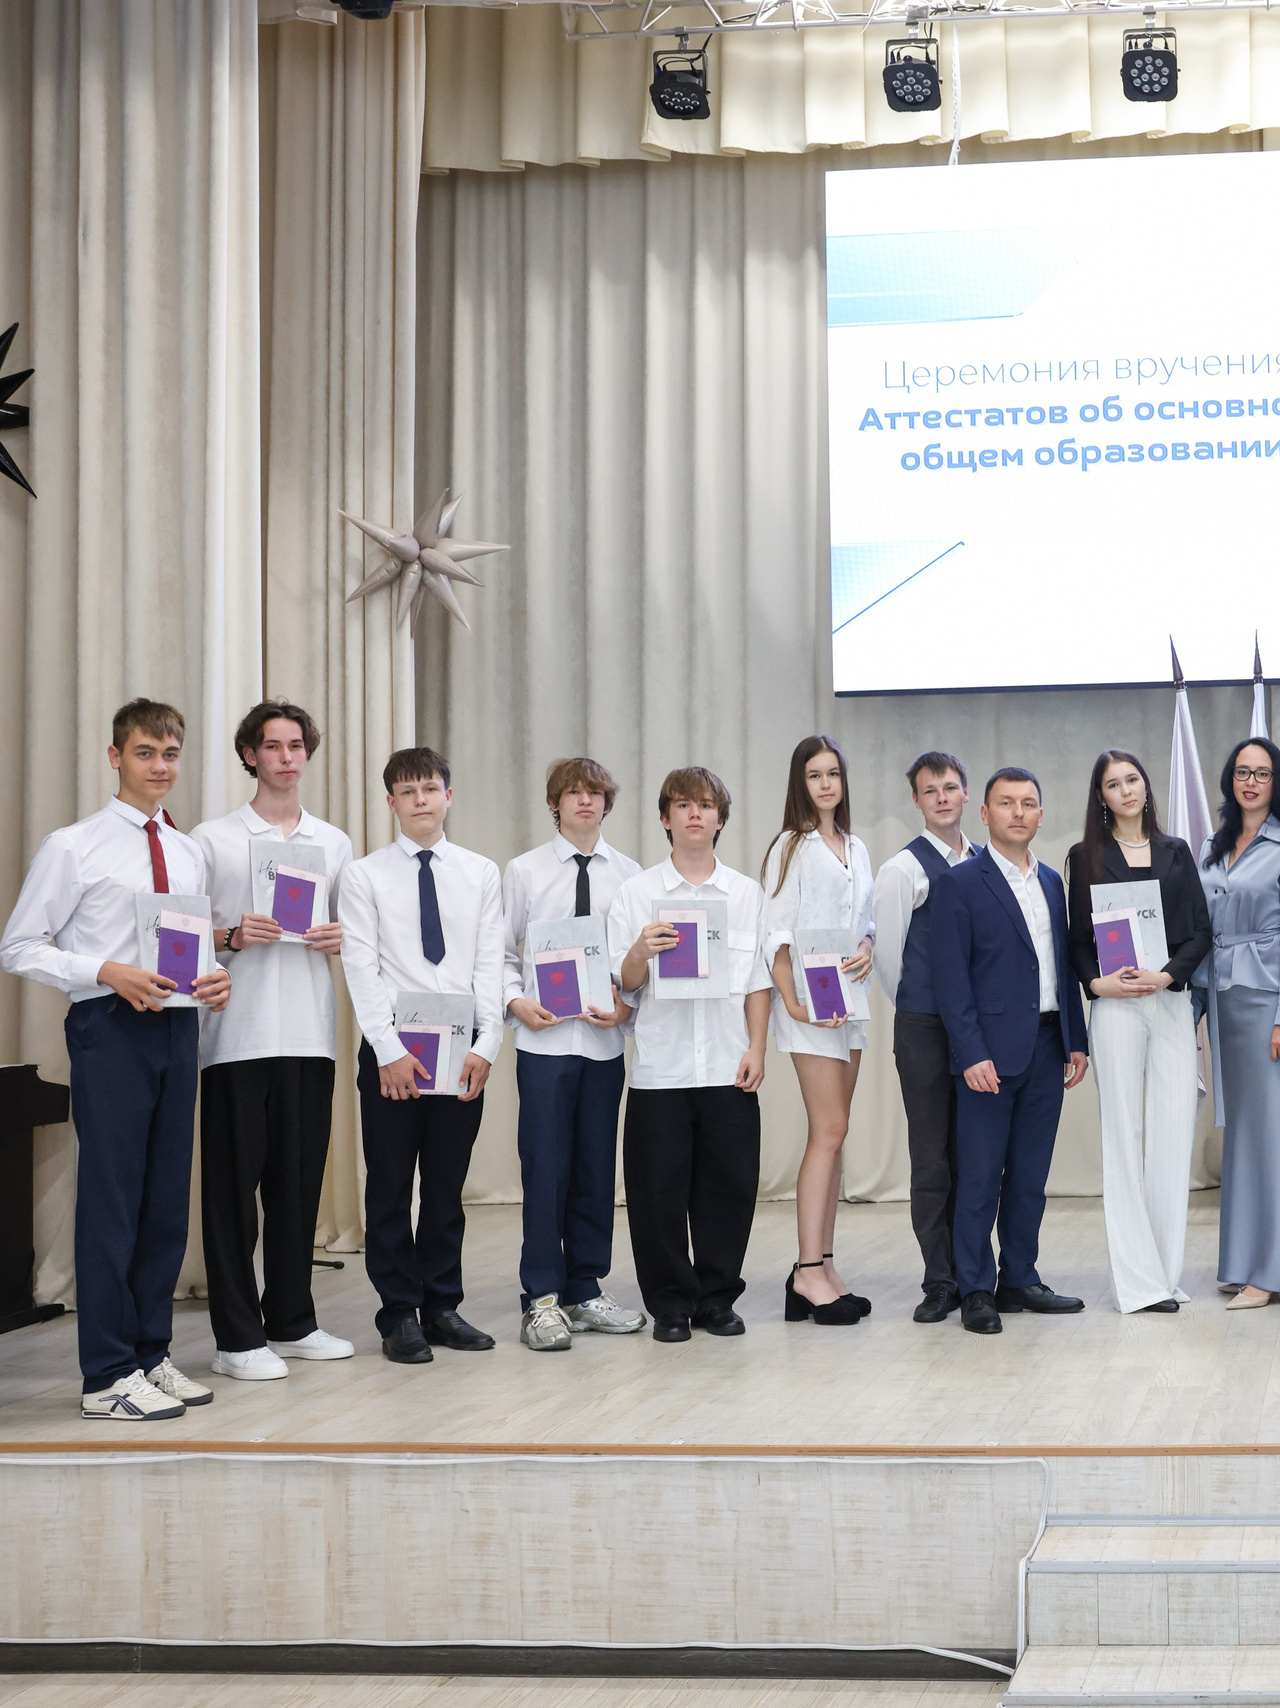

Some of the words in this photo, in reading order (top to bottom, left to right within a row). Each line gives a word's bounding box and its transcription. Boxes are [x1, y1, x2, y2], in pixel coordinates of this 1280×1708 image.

[884, 359, 1099, 393] Церемония
[858, 405, 1068, 431] Аттестатов
[1079, 395, 1123, 422] об
[901, 443, 1023, 473] общем
